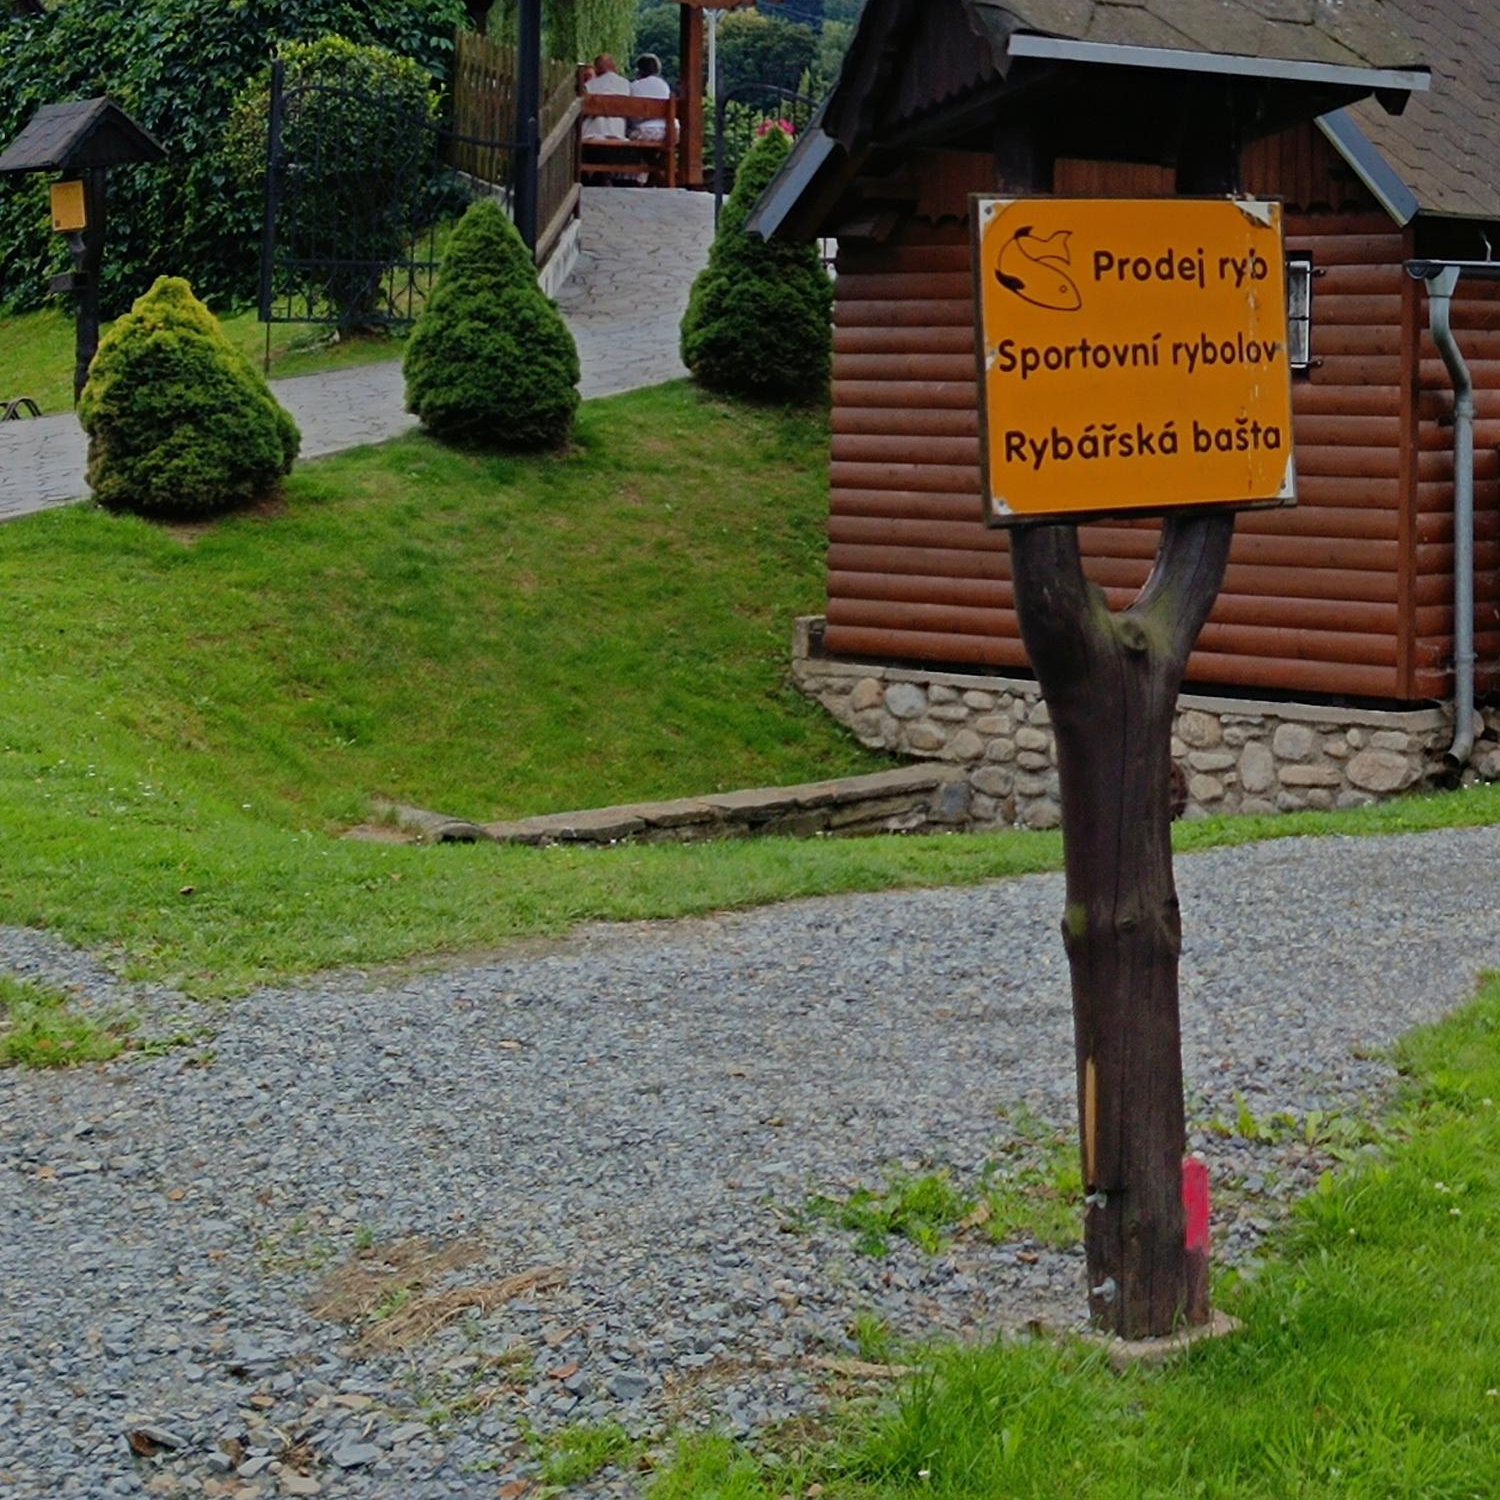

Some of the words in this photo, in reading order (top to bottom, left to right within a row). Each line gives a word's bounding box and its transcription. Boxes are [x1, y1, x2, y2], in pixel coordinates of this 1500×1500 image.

[1093, 248, 1205, 288] Prodej
[1219, 248, 1268, 288] ryb
[998, 333, 1162, 380] Sportovní
[1172, 332, 1278, 373] rybolov
[1005, 421, 1178, 471] Rybářská
[1192, 417, 1281, 453] bašta
